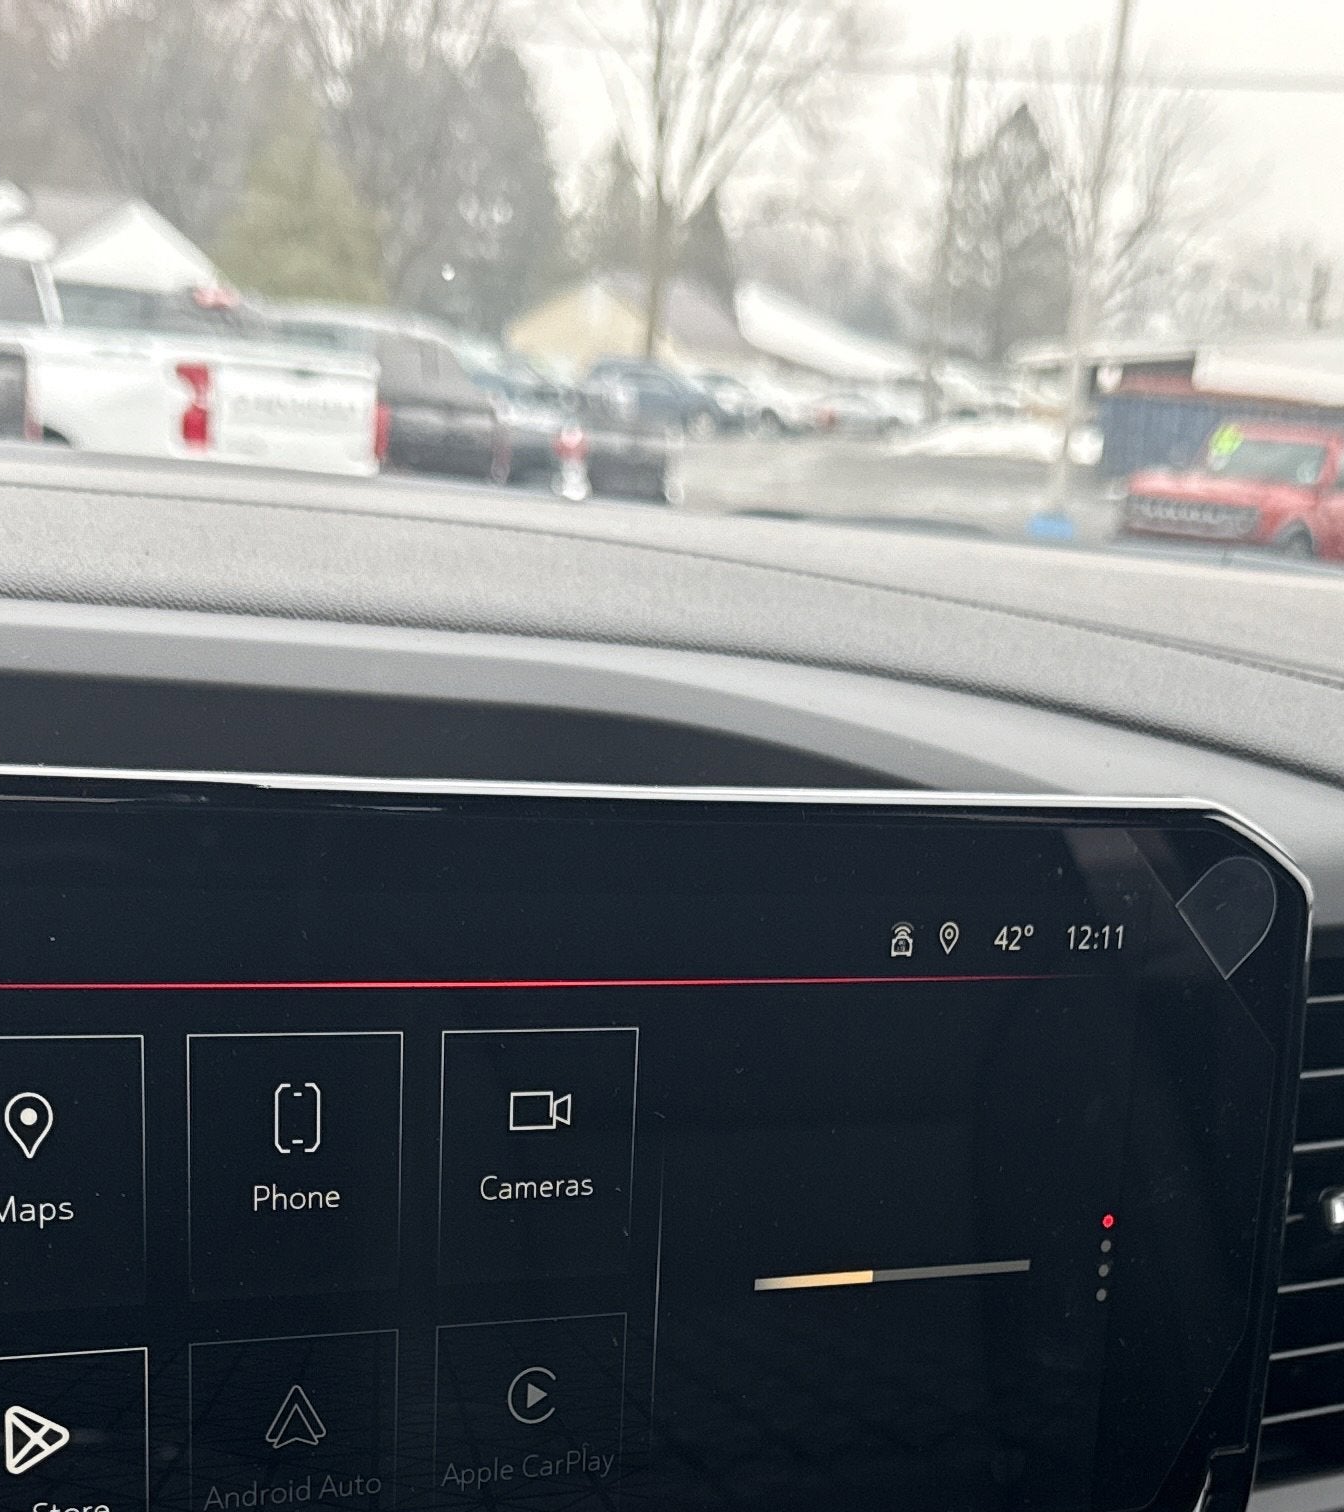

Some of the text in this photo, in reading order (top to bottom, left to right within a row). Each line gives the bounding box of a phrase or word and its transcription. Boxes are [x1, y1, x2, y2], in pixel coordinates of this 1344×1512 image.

[1067, 924, 1124, 950] 12:11
[253, 1183, 341, 1212] Phone
[480, 1174, 594, 1201] Cameras
[440, 1448, 615, 1488] Apple CarPlay
[203, 1474, 382, 1511] Android Auto
